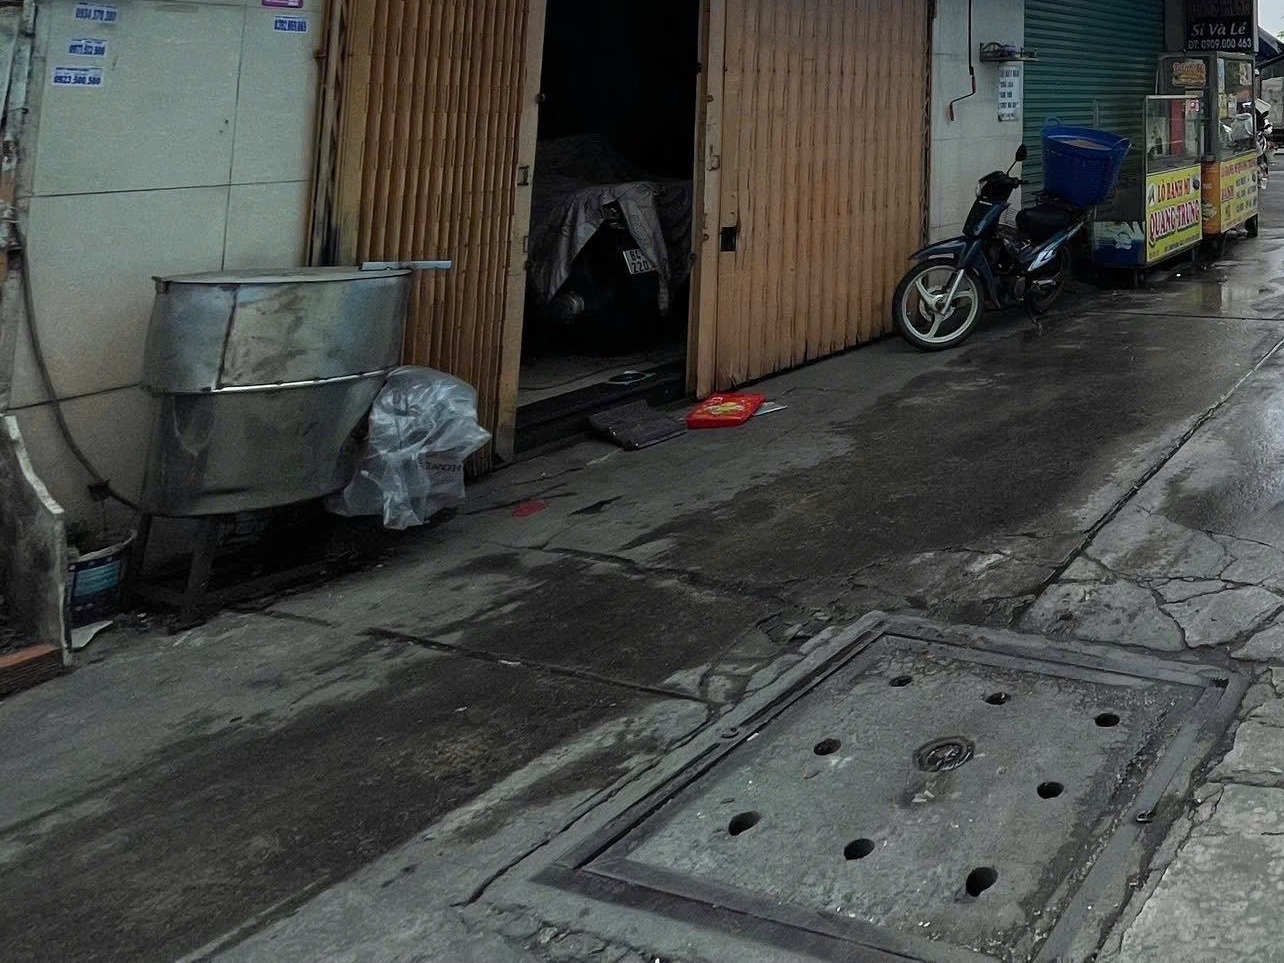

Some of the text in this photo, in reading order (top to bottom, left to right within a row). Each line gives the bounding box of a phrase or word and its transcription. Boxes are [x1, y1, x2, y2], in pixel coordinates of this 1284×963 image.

[1209, 22, 1226, 36] Và
[1237, 37, 1252, 48] 463
[1149, 207, 1176, 245] QUANG
[1177, 199, 1200, 227] TRUNG
